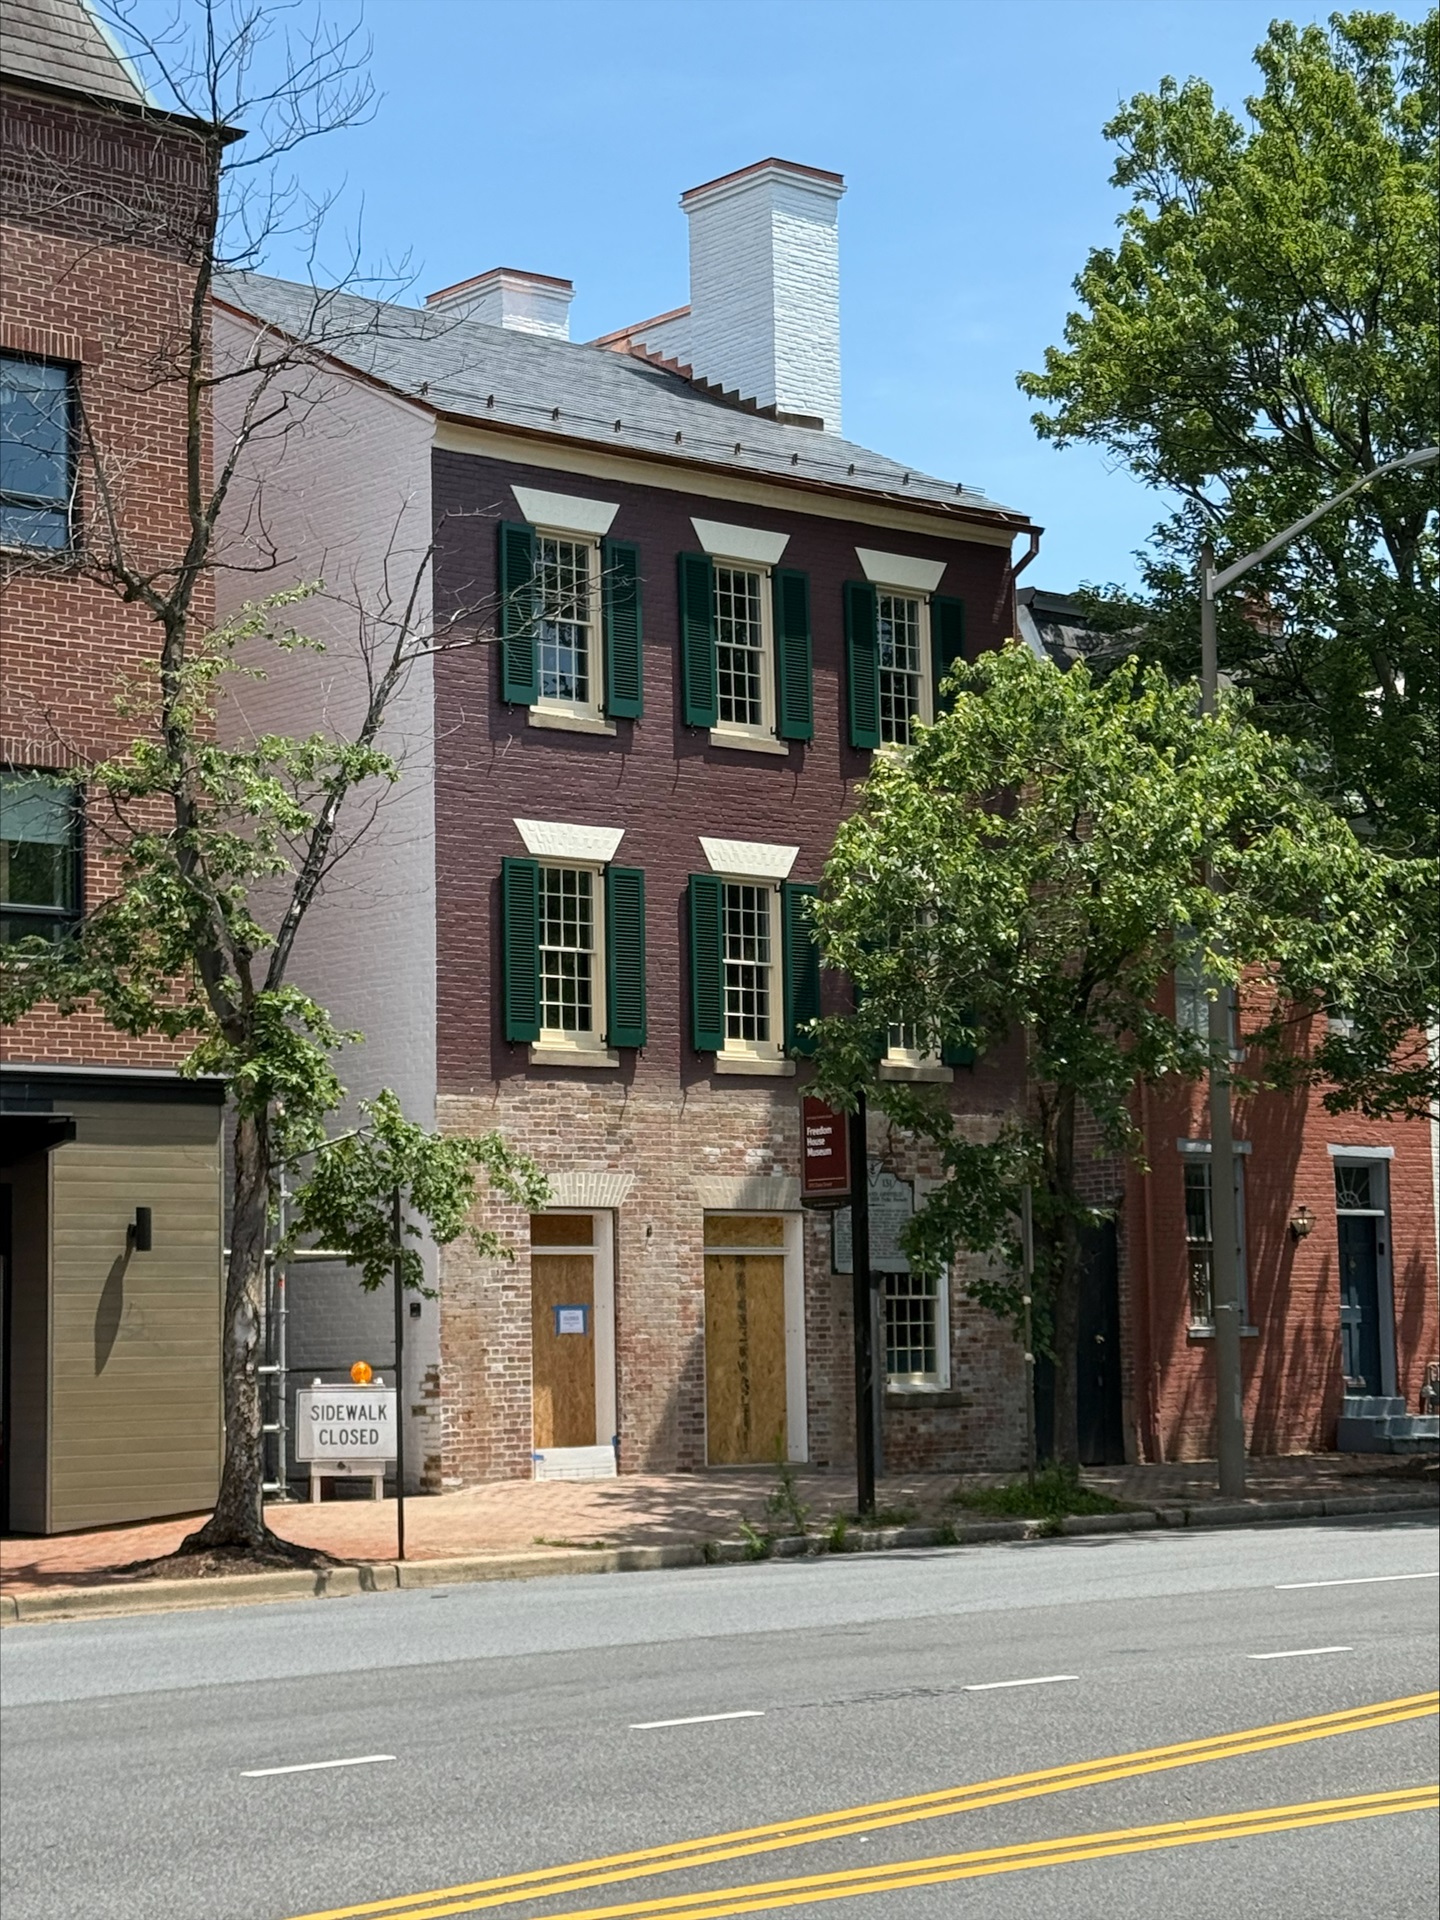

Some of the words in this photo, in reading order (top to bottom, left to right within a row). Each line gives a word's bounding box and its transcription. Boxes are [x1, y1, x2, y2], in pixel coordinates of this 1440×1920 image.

[806, 1125, 833, 1136] Freedom
[806, 1137, 826, 1147] House
[806, 1148, 833, 1157] Museum
[310, 1404, 388, 1422] SIDEWALK
[318, 1428, 380, 1446] CLOSED
